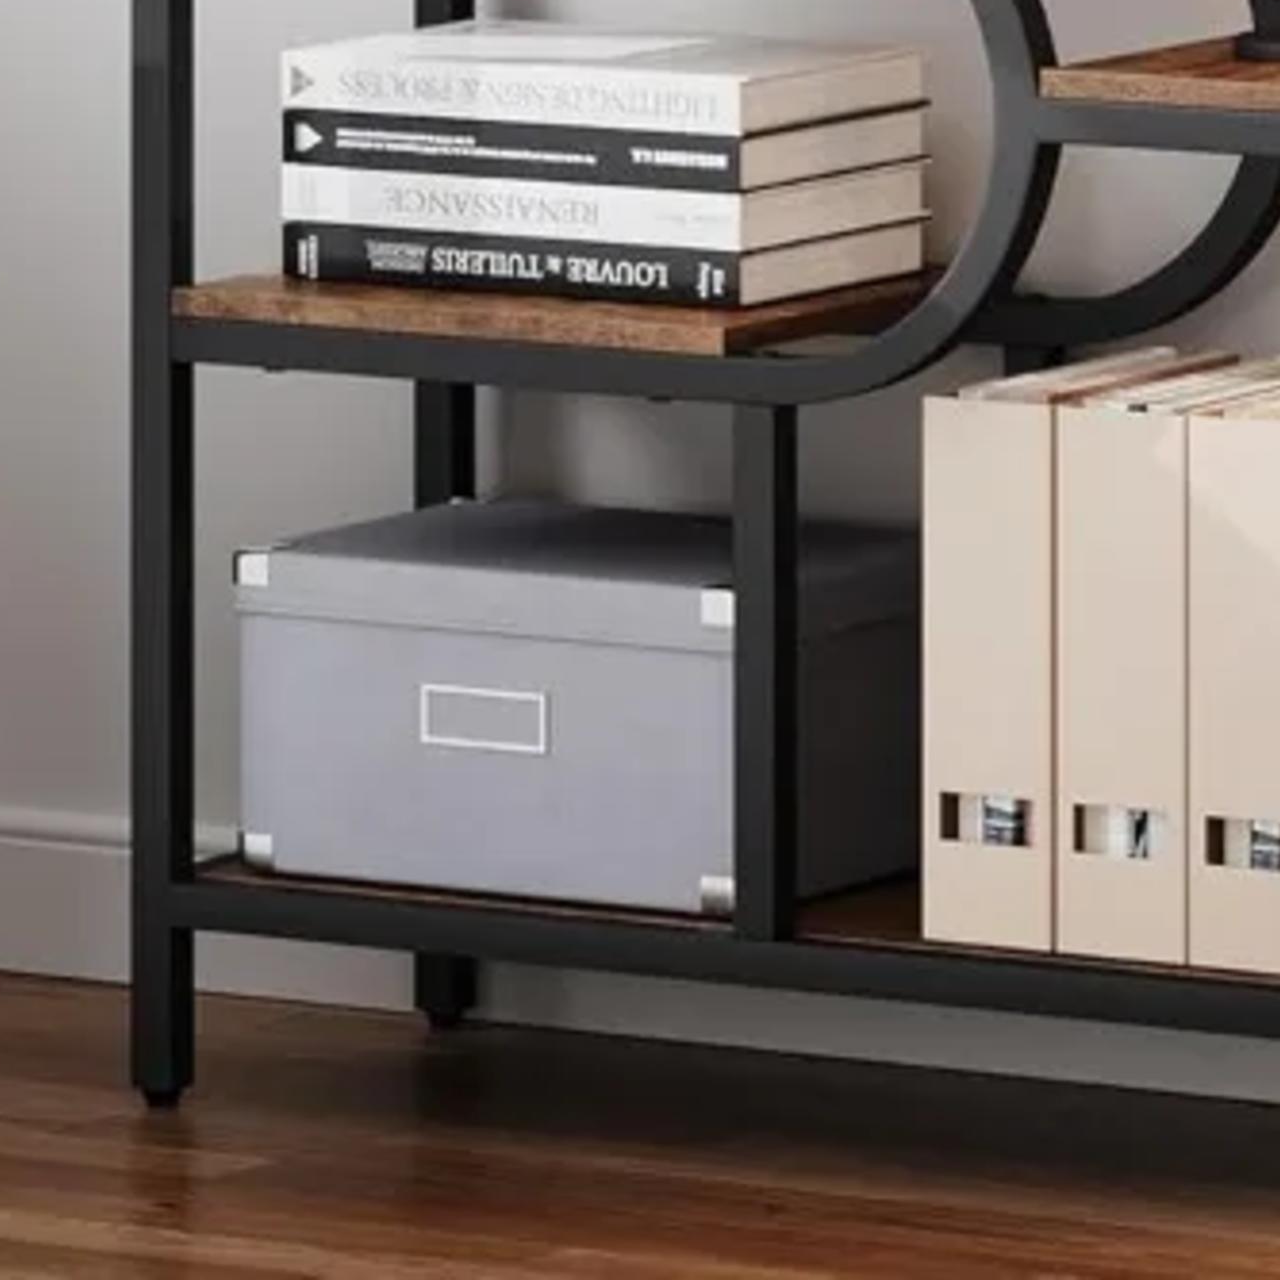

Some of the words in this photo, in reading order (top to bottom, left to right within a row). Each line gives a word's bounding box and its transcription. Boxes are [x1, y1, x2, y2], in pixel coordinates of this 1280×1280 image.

[338, 67, 452, 101] PROCESS
[385, 186, 600, 227] RENAISSANCE
[567, 256, 669, 290] LOUVRE
